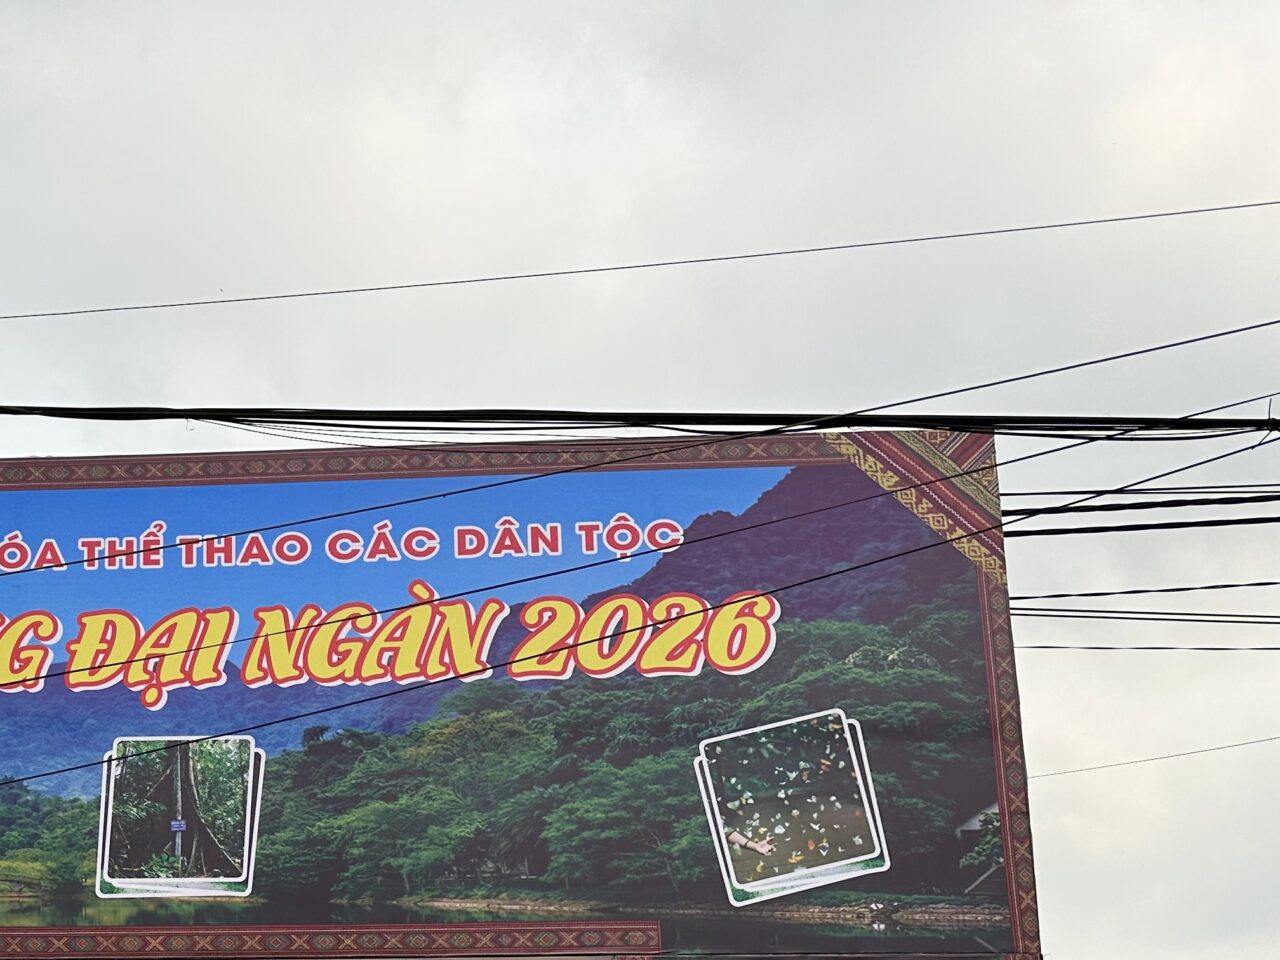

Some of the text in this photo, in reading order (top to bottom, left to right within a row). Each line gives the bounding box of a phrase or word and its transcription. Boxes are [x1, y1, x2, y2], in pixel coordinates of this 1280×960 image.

[79, 520, 163, 571] THỂ
[176, 530, 311, 568] THAO
[326, 521, 440, 564] CÁC
[453, 517, 561, 559] DÂN
[575, 513, 683, 562] TỘC
[64, 607, 239, 713] ĐẠI
[239, 578, 509, 688] NGÀN
[507, 588, 782, 682] 2026
